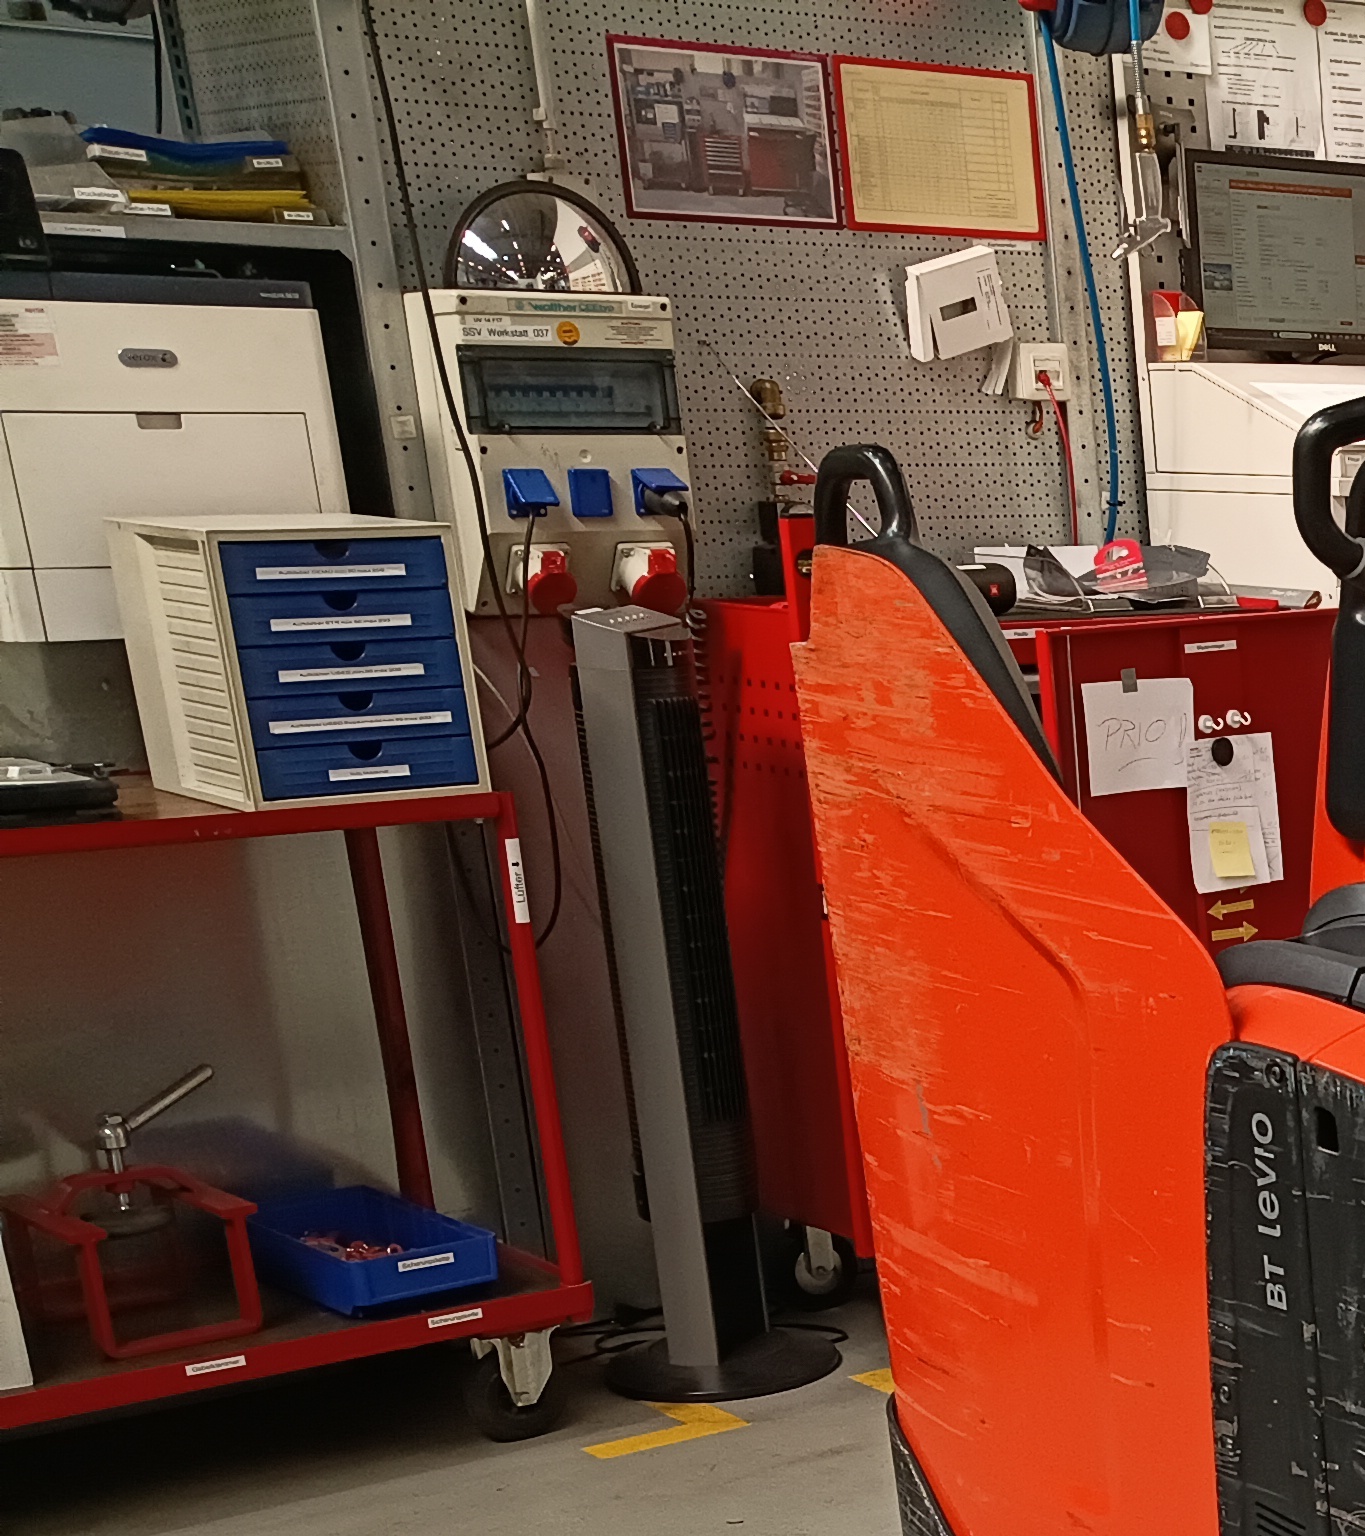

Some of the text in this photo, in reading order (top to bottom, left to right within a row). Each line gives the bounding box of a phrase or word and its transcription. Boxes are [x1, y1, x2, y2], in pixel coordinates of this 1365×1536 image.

[533, 328, 549, 338] 037
[1318, 343, 1337, 352] DELL
[513, 871, 527, 904] Lüfter
[1262, 1253, 1288, 1311] BT
